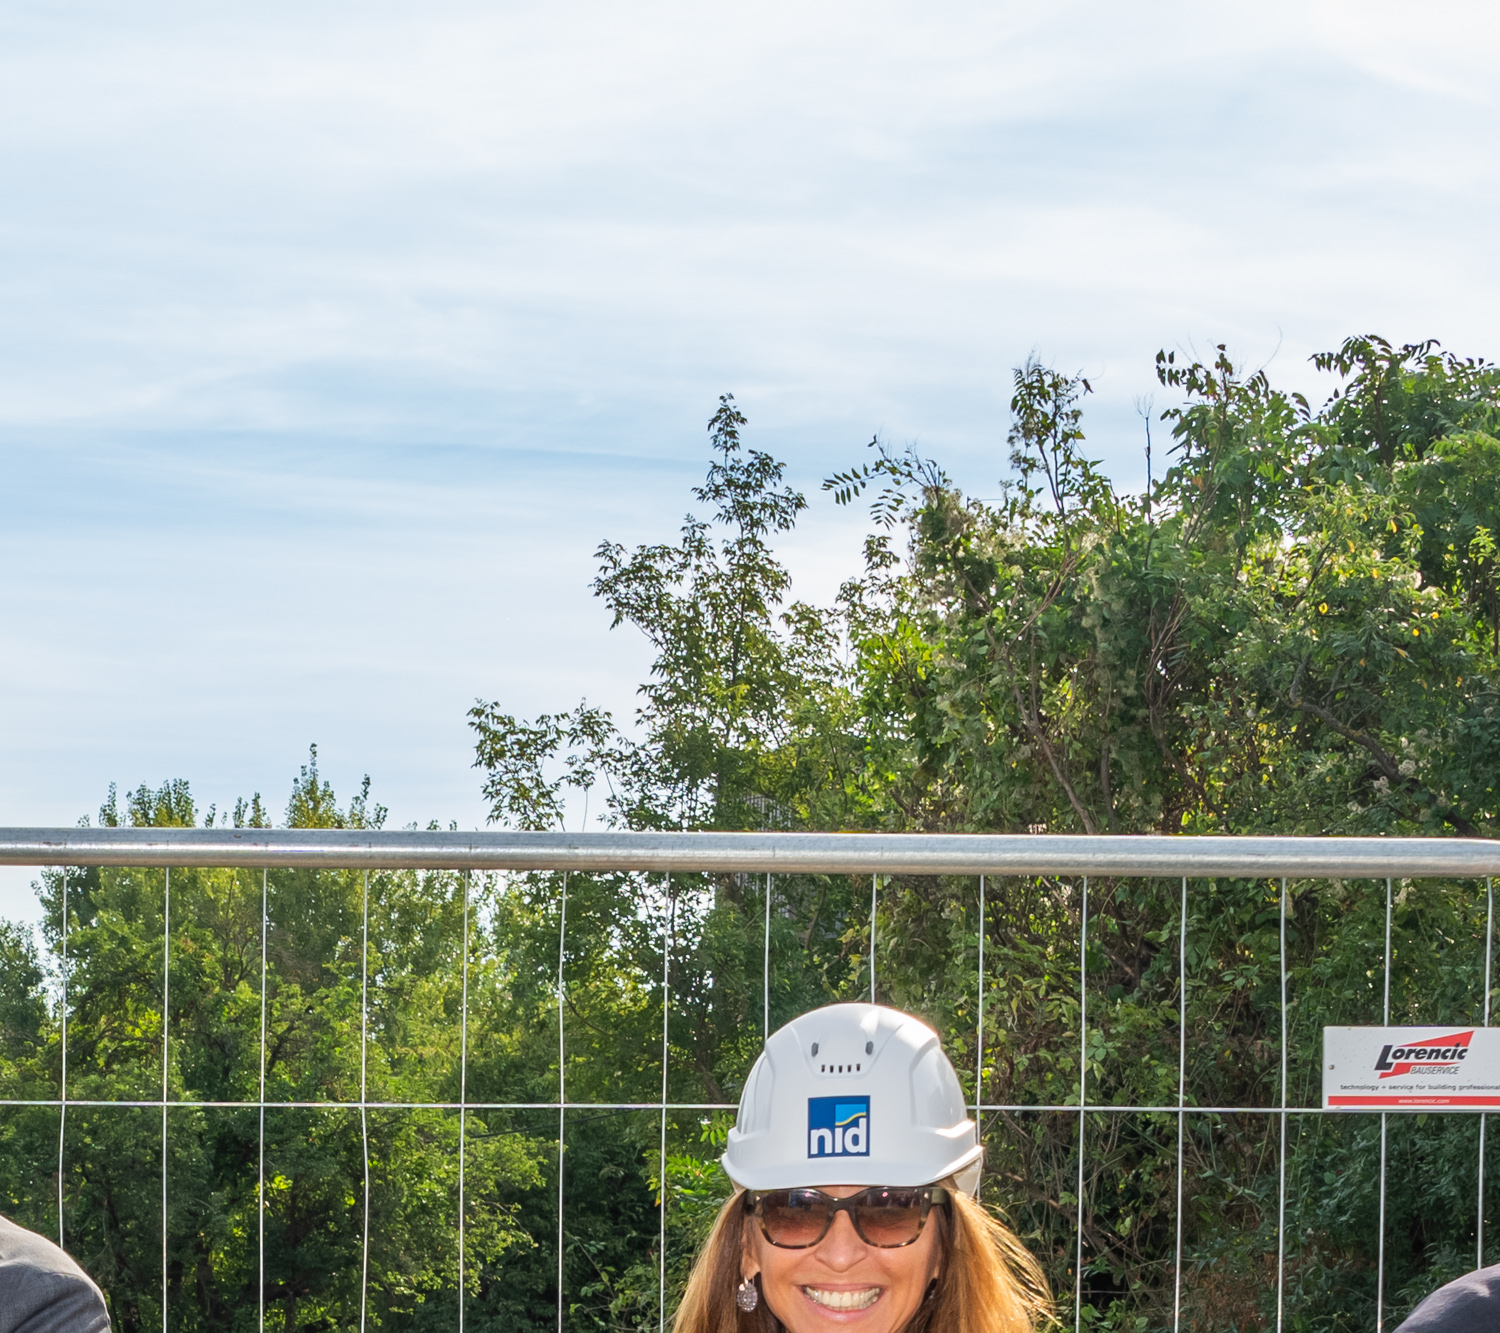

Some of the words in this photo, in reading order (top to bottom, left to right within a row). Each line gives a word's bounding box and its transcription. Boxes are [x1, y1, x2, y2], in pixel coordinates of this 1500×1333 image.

[1374, 1043, 1468, 1071] Lorencic
[1410, 1066, 1461, 1075] BAUSERVICE
[810, 1117, 867, 1155] nid
